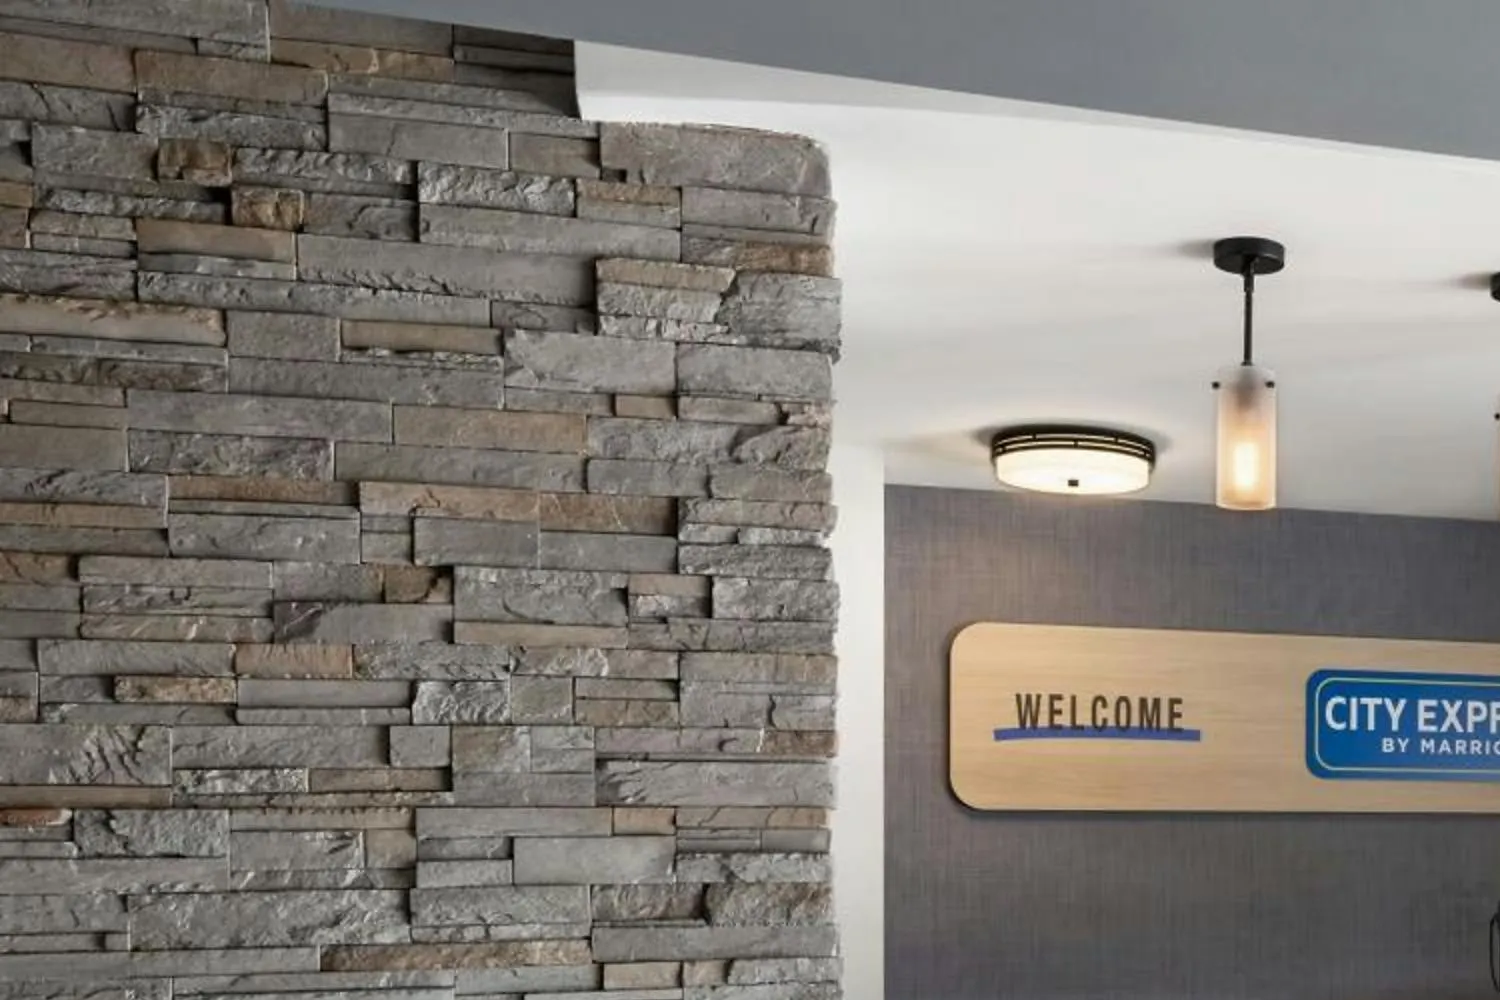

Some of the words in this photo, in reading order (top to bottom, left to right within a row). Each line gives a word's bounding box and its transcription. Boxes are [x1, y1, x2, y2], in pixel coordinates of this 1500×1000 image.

[1015, 693, 1184, 732] WELCOME
[1325, 695, 1406, 732] CITY
[1382, 737, 1410, 753] BY
